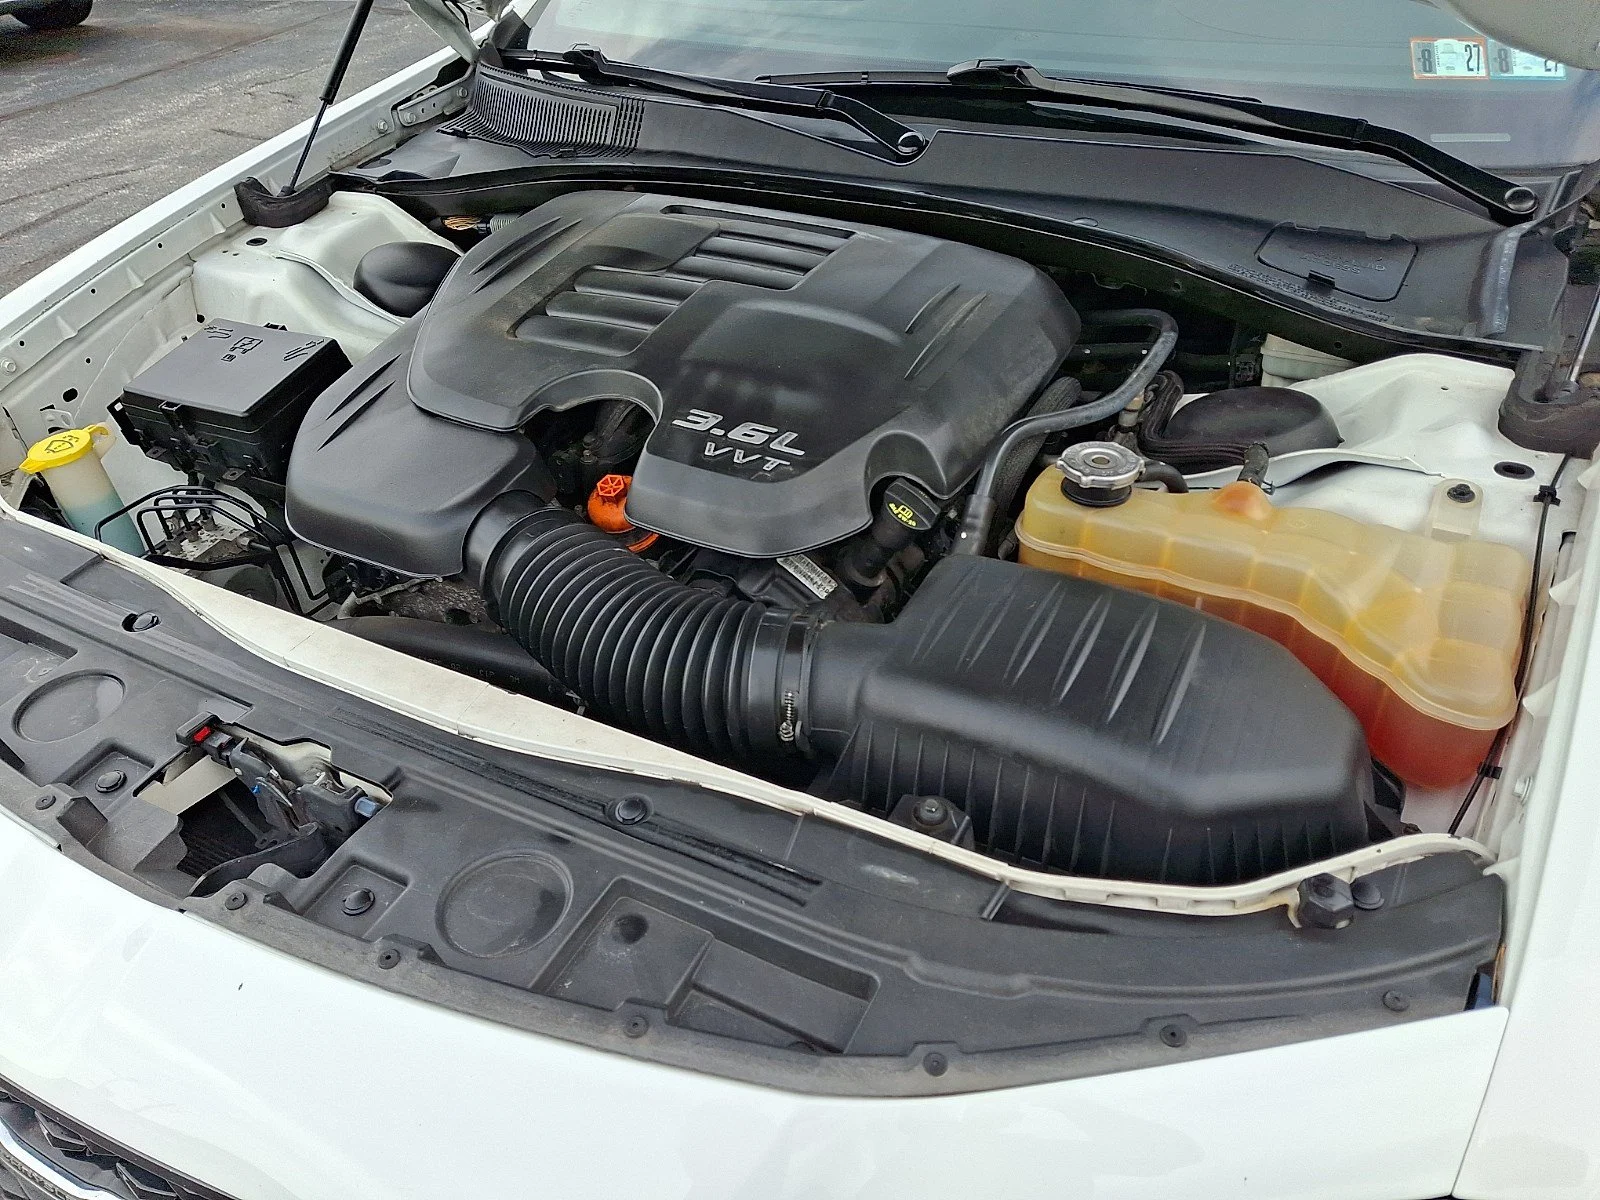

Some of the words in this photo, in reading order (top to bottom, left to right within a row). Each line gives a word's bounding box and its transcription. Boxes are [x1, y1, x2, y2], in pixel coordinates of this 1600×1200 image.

[1420, 48, 1433, 73] 8
[1464, 43, 1481, 73] 27
[1497, 48, 1510, 73] 8
[671, 408, 805, 456] 3.6L
[704, 441, 791, 471] VVT
